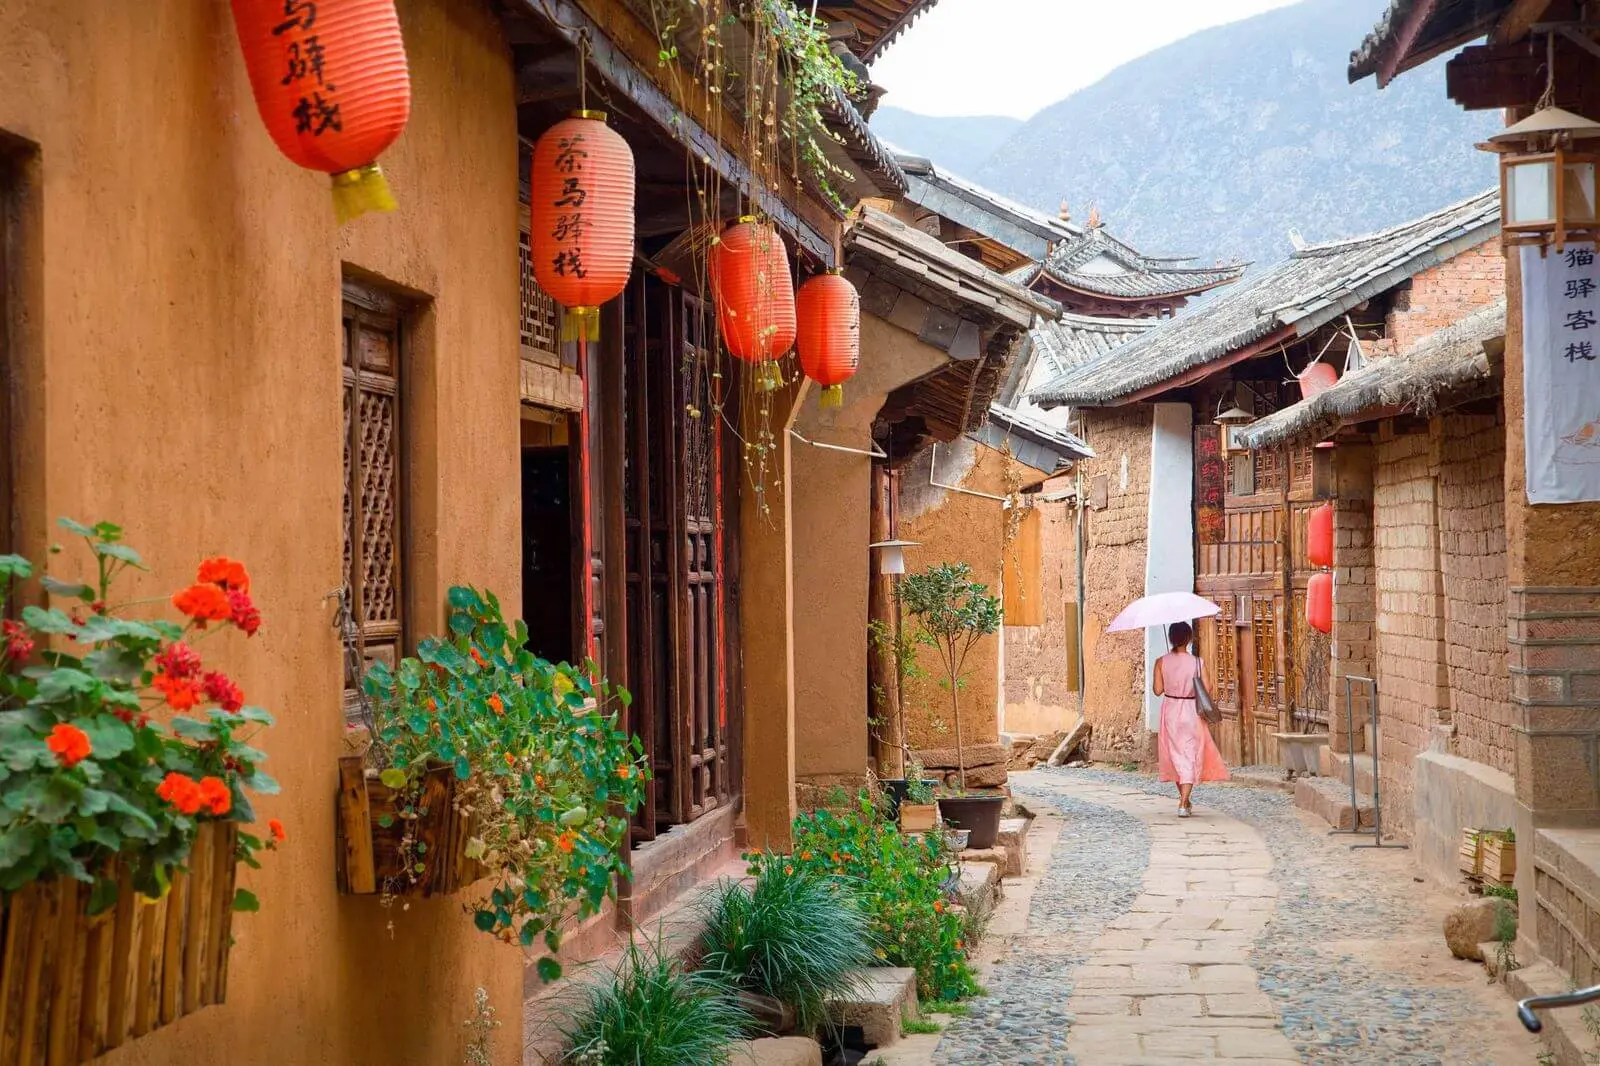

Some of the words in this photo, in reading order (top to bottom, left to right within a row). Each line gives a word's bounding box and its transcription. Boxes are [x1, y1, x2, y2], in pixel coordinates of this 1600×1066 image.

[552, 133, 593, 279] 茶马驿栈
[1563, 248, 1597, 363] 猫驿客栈
